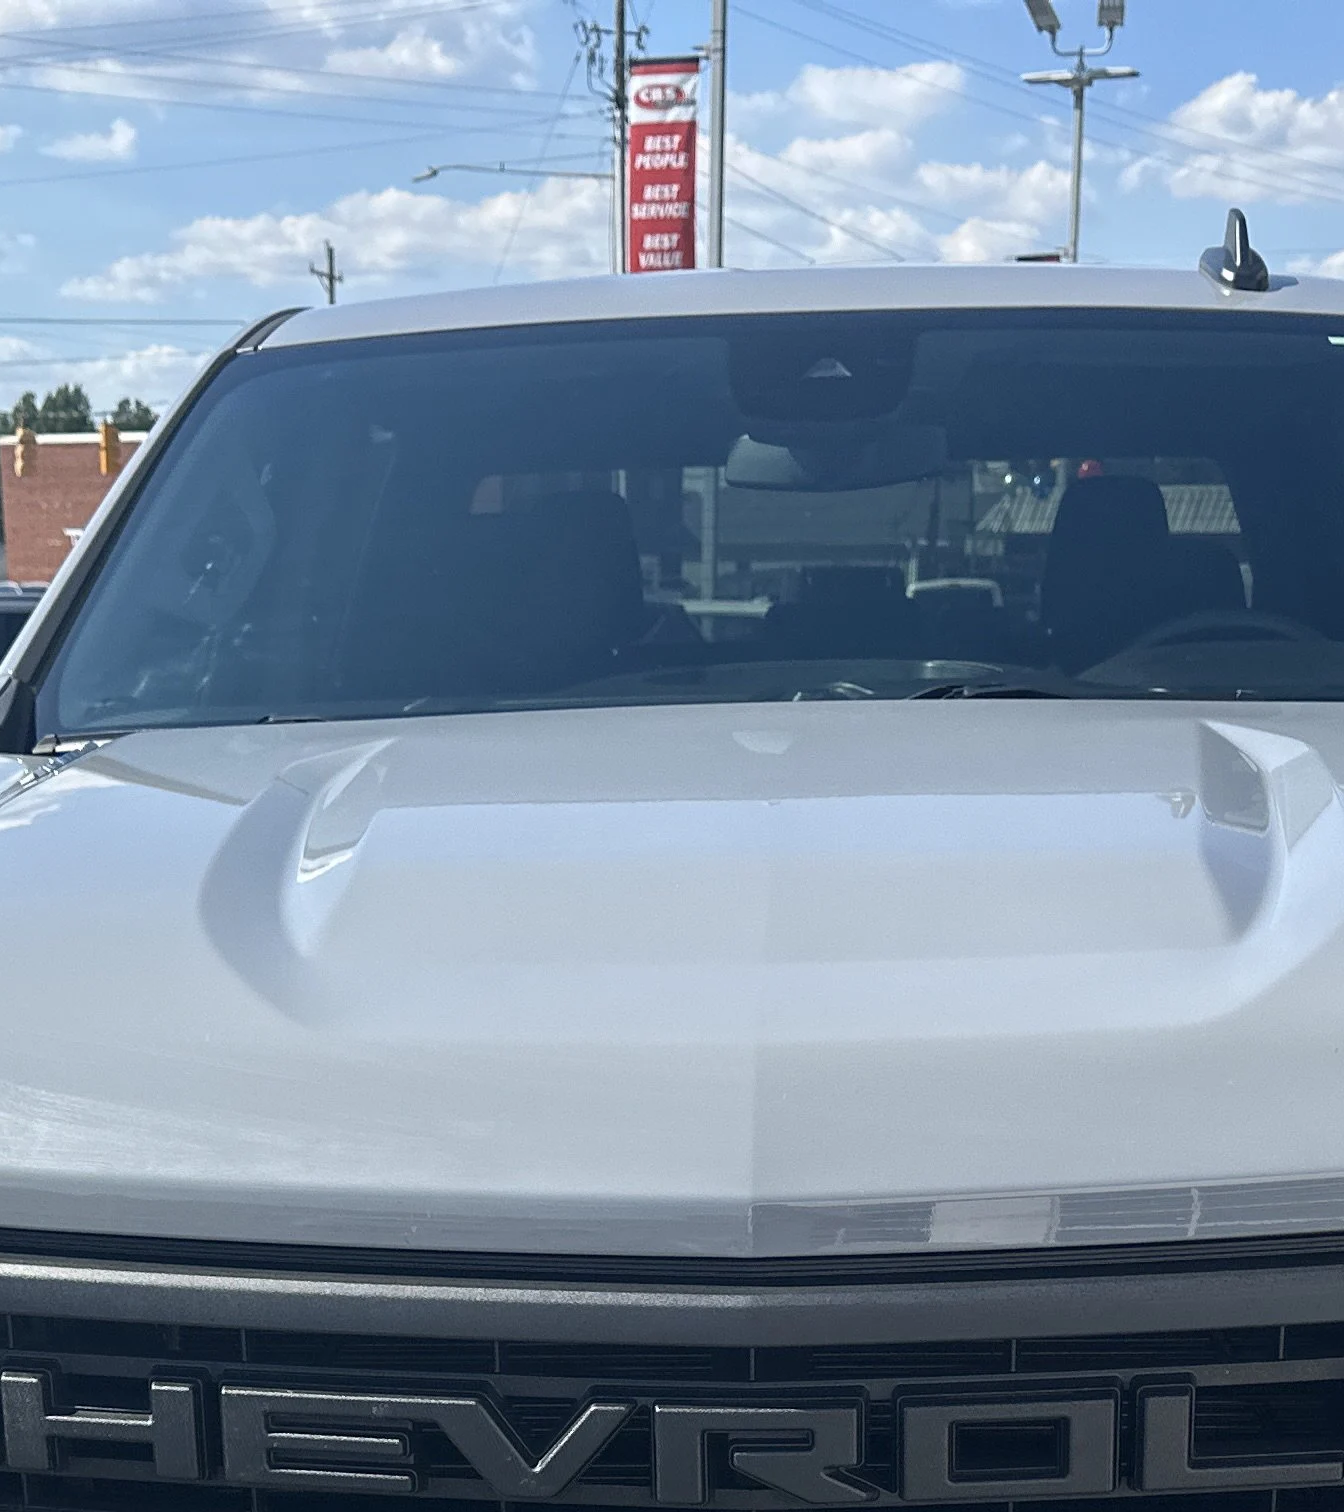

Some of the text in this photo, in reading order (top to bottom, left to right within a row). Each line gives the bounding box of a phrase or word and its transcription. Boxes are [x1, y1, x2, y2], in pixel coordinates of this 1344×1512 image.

[643, 134, 683, 152] BEST
[634, 151, 689, 170] PEOPLE
[642, 183, 681, 201] BEST
[630, 201, 691, 220] SERVICE
[642, 232, 681, 250] BEST
